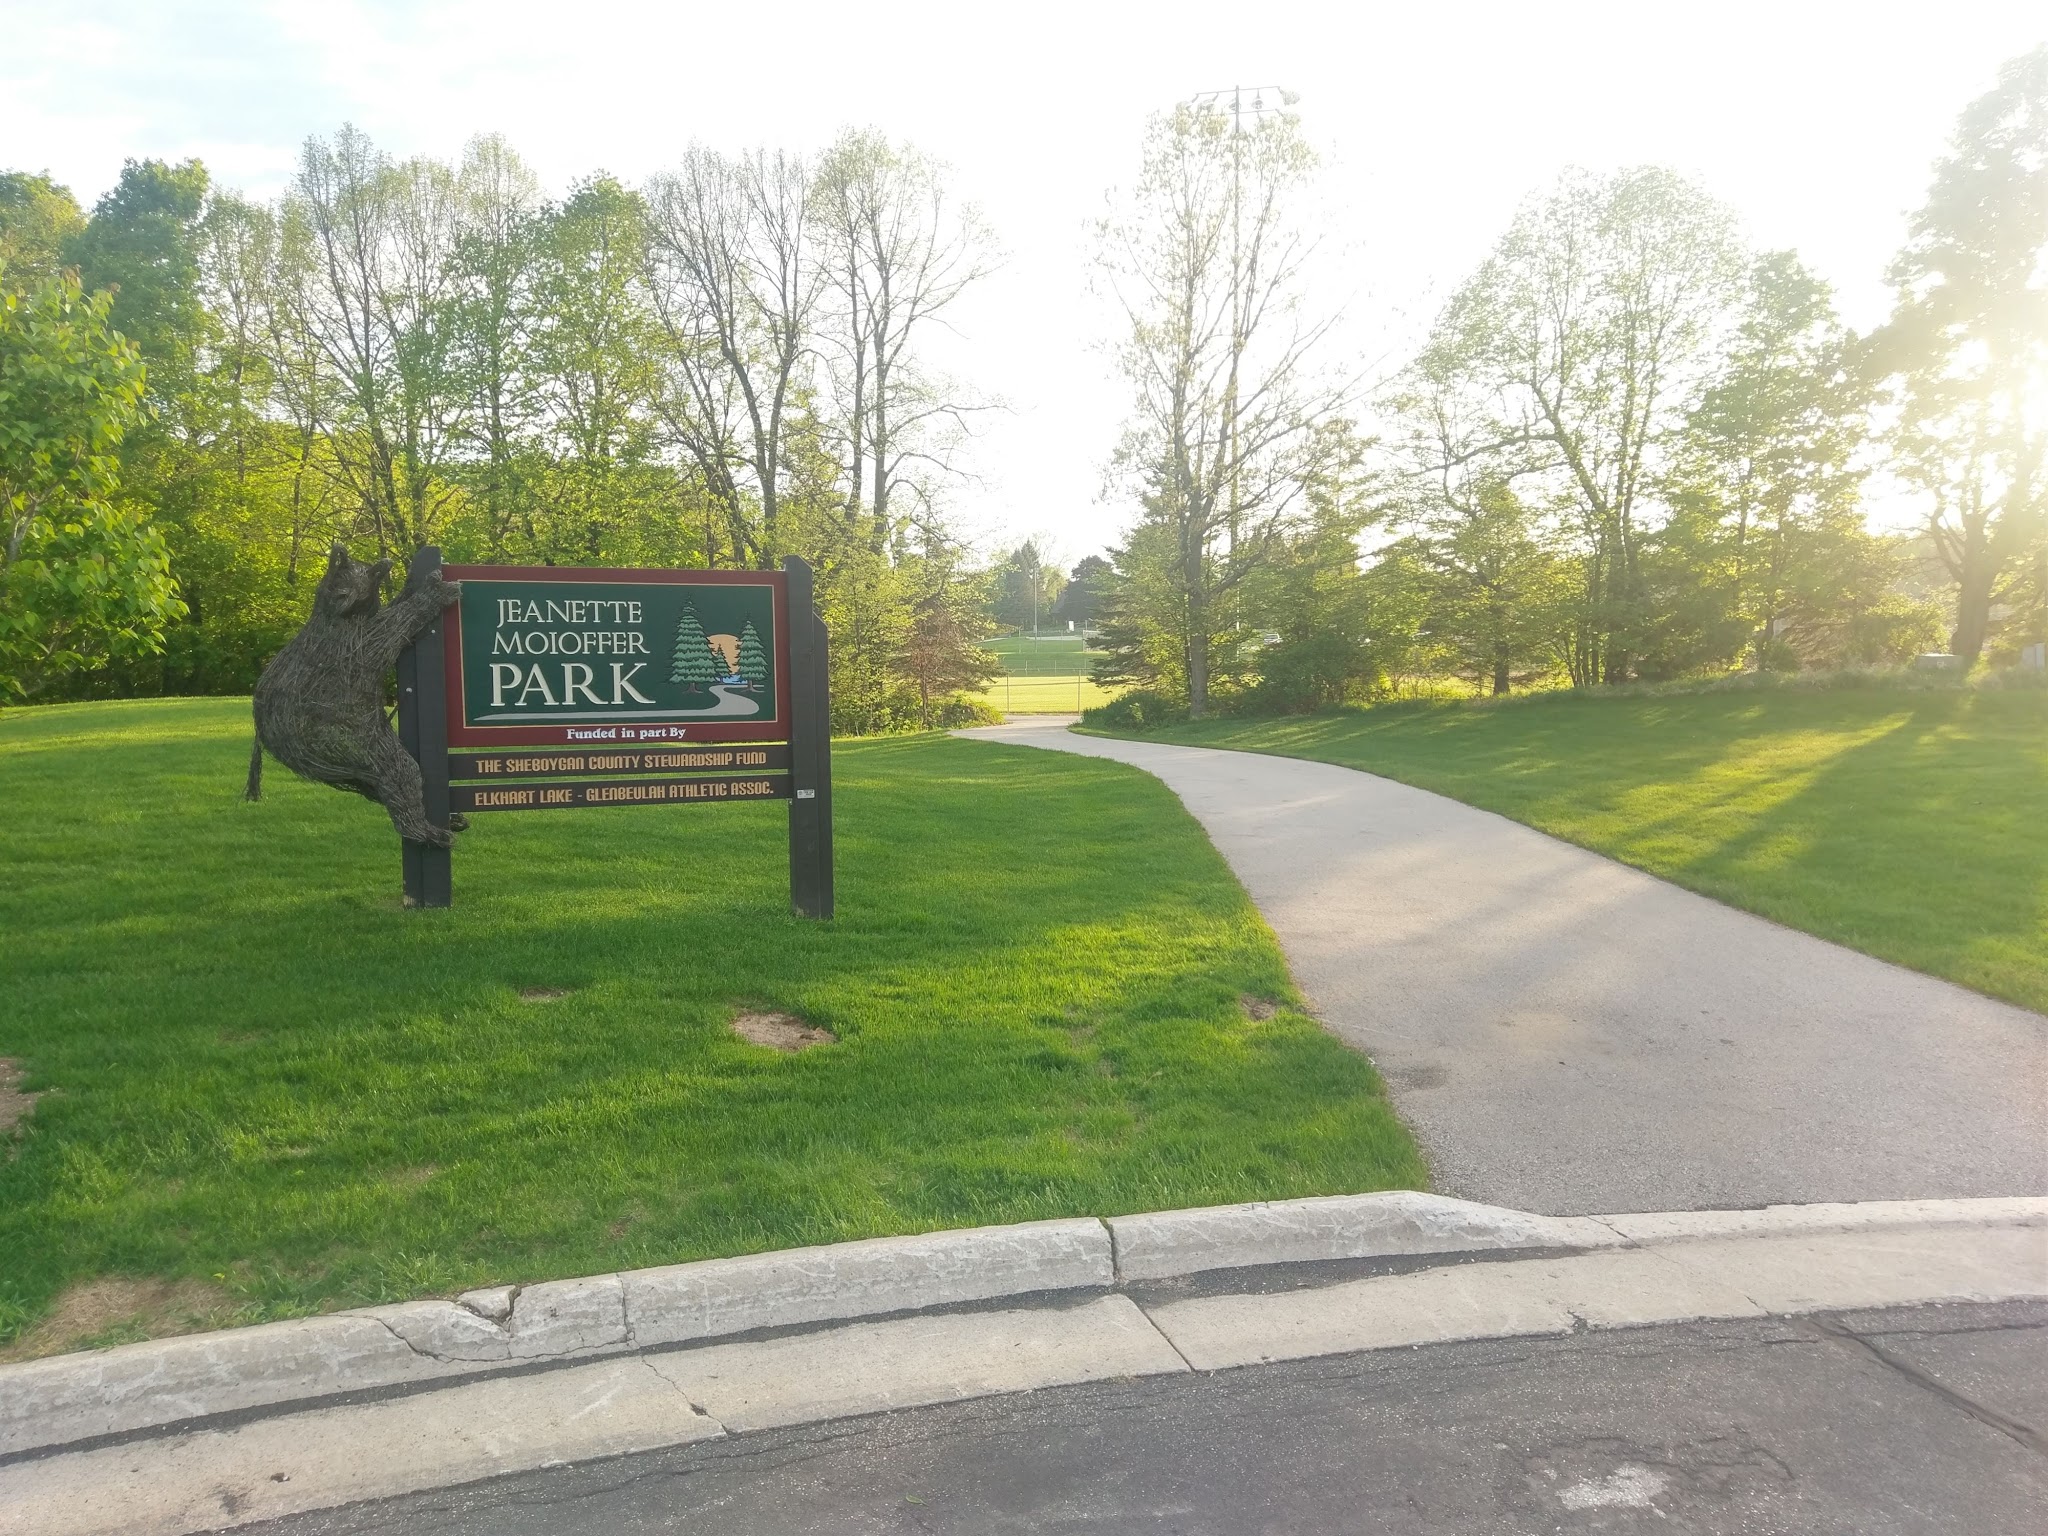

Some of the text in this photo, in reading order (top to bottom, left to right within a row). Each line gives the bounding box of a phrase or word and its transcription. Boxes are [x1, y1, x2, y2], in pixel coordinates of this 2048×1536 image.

[497, 599, 642, 628] JEANETTE
[492, 631, 650, 655] MOIOFFER
[489, 662, 656, 706] PARK
[566, 727, 686, 739] Funded in part By
[476, 752, 767, 773] THE SHEBOYGAN COUNTY STEWARDSHIP FUND
[475, 790, 535, 806] ELKHART
[540, 789, 573, 803] LAKE
[586, 785, 666, 801] GLENBEULAH
[669, 783, 727, 798] ATHLETIC
[731, 781, 774, 796] ASSOC.
